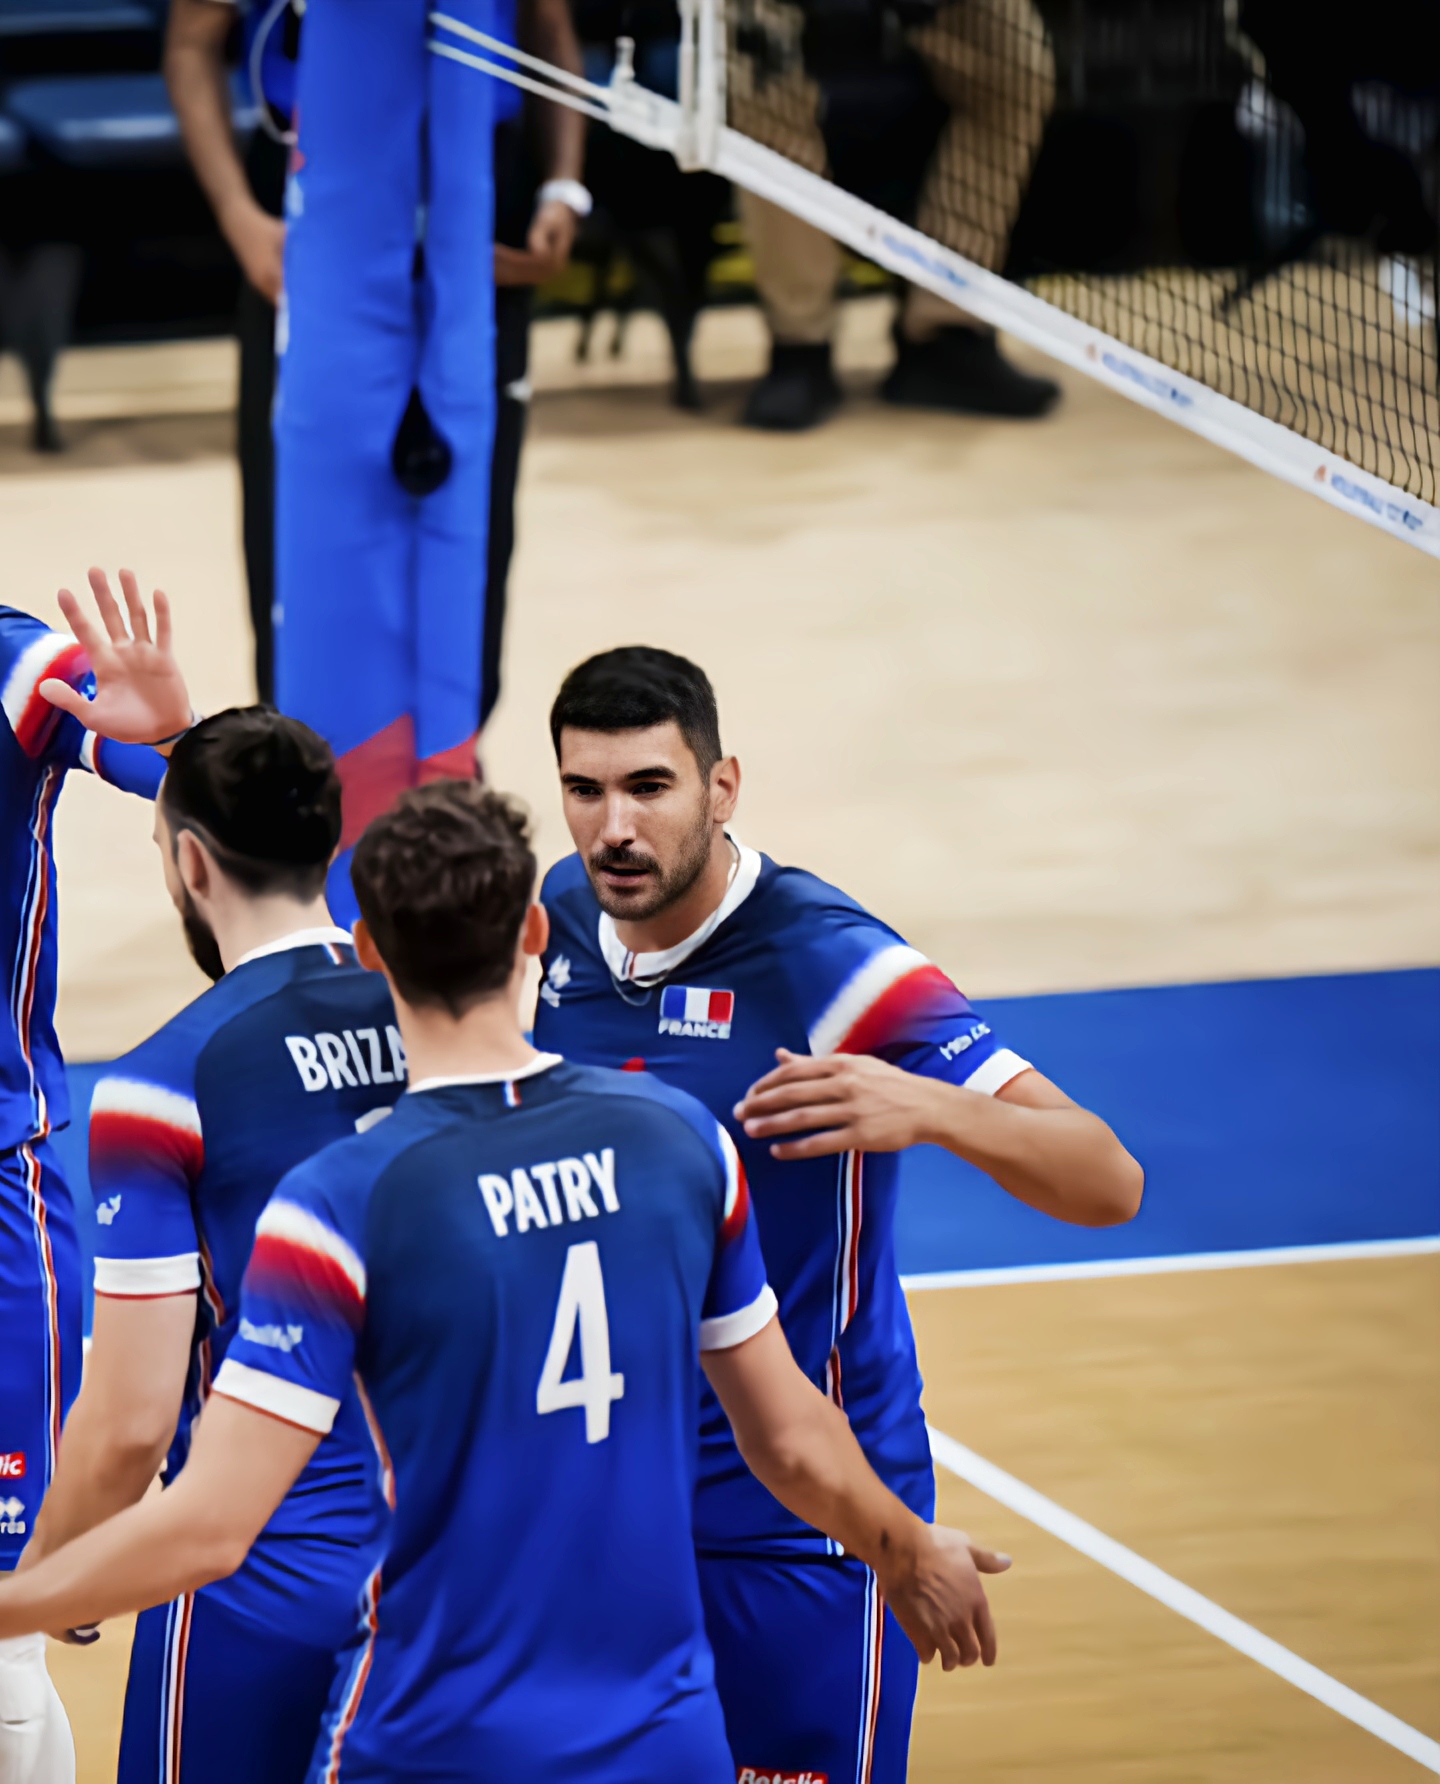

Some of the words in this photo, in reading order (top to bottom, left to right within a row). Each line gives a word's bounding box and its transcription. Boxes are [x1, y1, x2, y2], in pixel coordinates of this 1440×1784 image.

[284, 1024, 409, 1093] BRIZA
[658, 1019, 731, 1040] FRANCE
[477, 1147, 621, 1238] PATRY
[536, 1240, 625, 1445] 4
